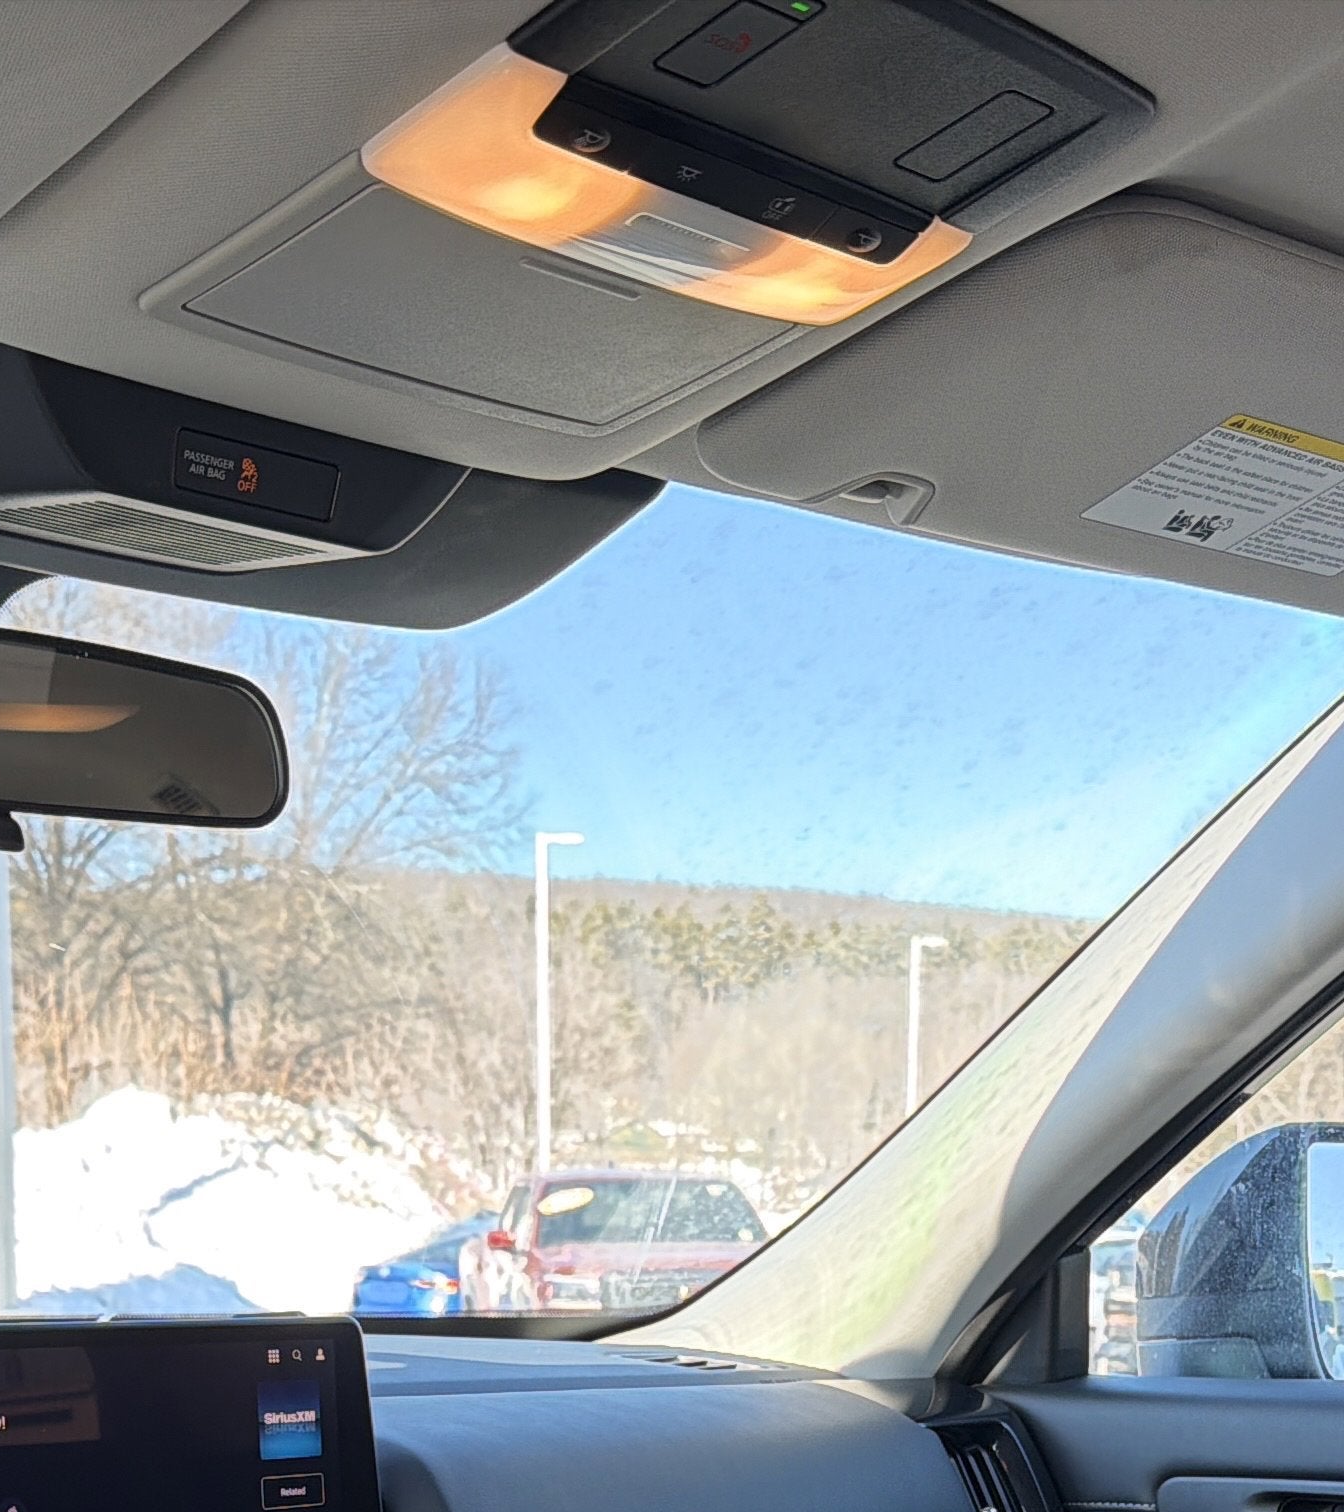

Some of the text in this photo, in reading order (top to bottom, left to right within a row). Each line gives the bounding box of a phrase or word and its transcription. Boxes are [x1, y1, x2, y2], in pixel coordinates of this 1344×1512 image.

[1246, 423, 1299, 443] WARNING
[1210, 429, 1237, 440] EVEN
[1235, 436, 1261, 447] WITH
[1258, 443, 1307, 460] ADVANCED
[1305, 457, 1324, 465] AIR
[183, 449, 235, 471] PASSENGER
[189, 463, 226, 481] AIR BAG
[237, 480, 257, 493] OFF
[264, 1410, 316, 1425] SiriusXM
[280, 1486, 307, 1497] Related
